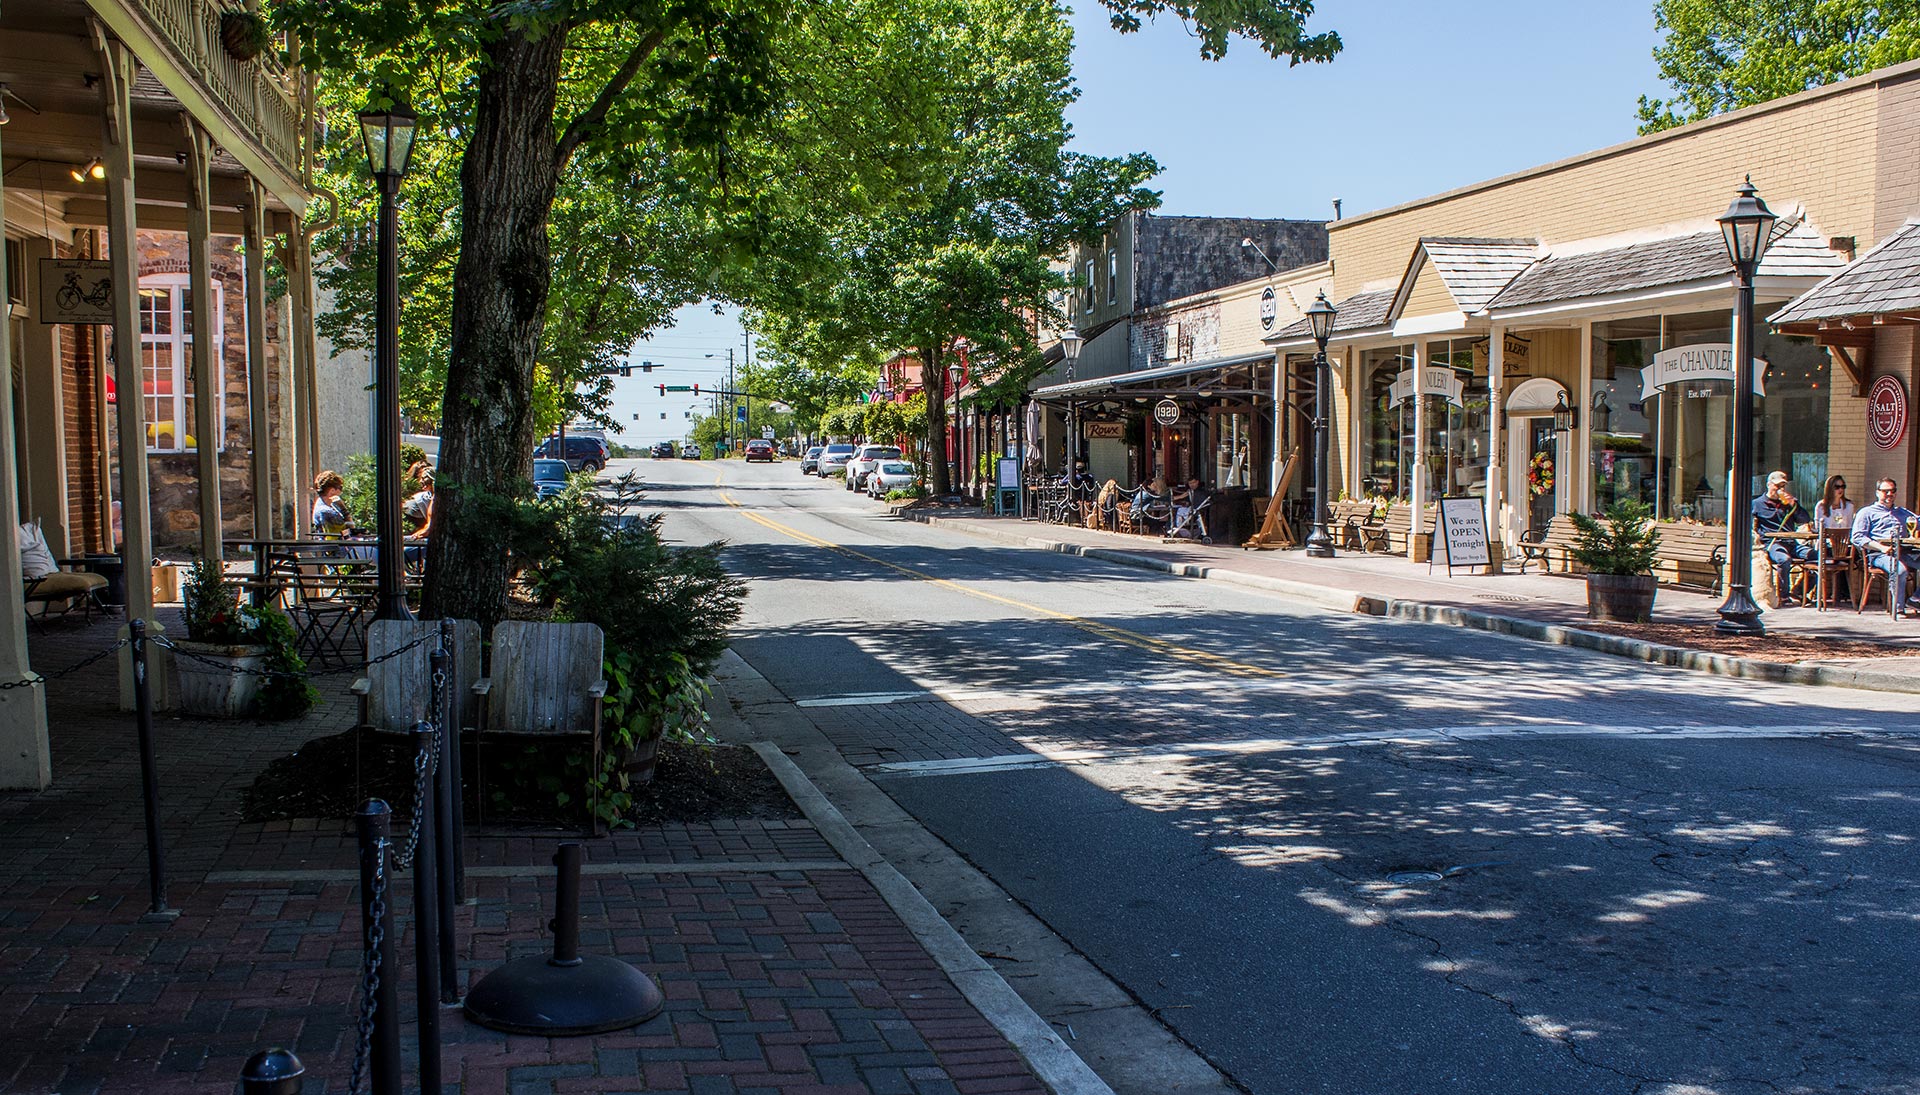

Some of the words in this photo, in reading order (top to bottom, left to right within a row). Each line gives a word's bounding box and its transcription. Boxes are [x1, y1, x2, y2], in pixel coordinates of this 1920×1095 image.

[1260, 298, 1276, 318] 1920
[1664, 359, 1678, 372] THE
[1680, 350, 1732, 372] CHANDLER
[1425, 371, 1449, 389] NDLERY
[1700, 389, 1712, 398] 1977
[1157, 406, 1177, 417] 1920
[1876, 402, 1895, 412] SALT
[1090, 425, 1118, 437] Roux
[1450, 517, 1464, 525] We
[1452, 528, 1480, 537] OPEN
[1451, 540, 1484, 549] Tonight
